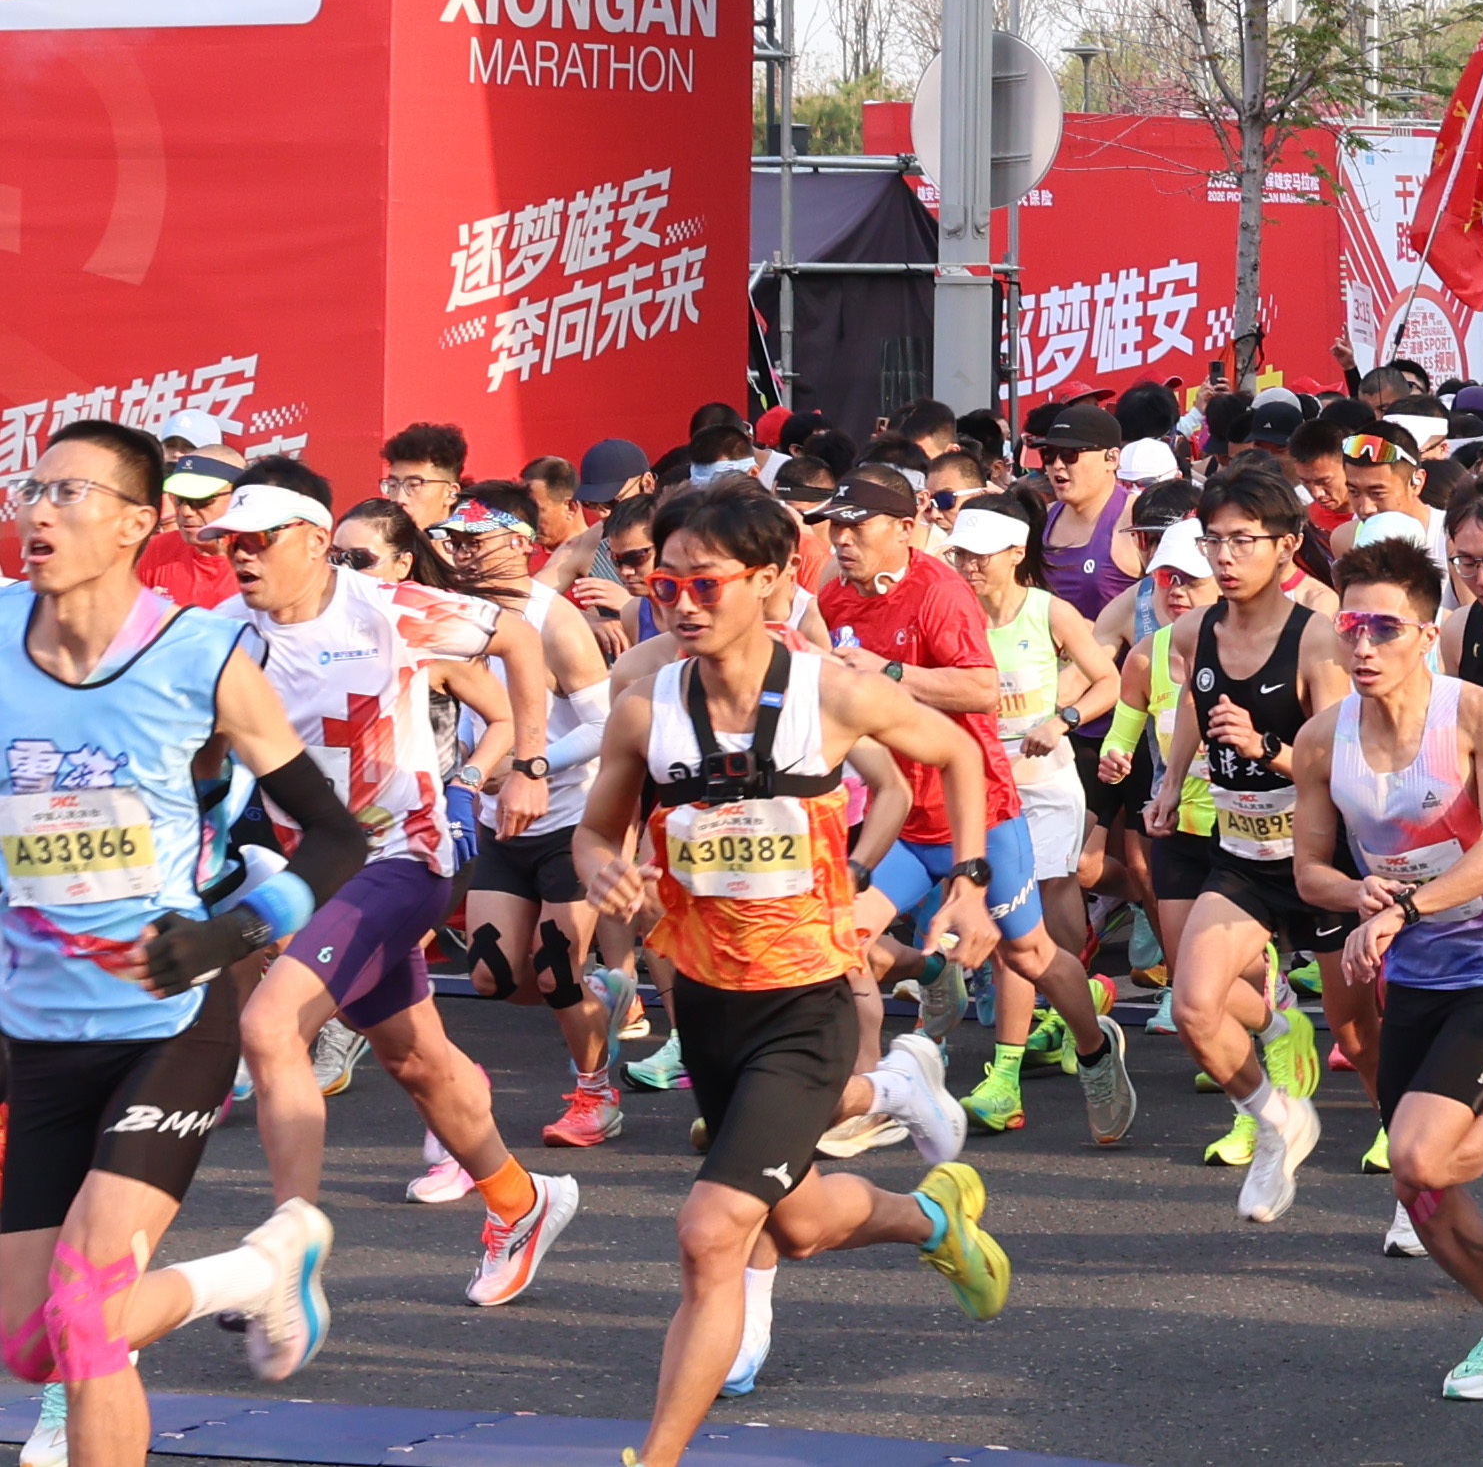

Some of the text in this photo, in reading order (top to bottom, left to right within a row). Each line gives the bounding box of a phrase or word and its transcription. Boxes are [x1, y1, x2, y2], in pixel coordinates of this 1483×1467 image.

[468, 35, 697, 95] MARATHON
[445, 166, 673, 313] 逐梦雄安
[486, 244, 707, 394] 奔向未来
[1423, 337, 1452, 351] SPORT
[15, 828, 137, 867] A33866
[676, 834, 797, 865] A30382
